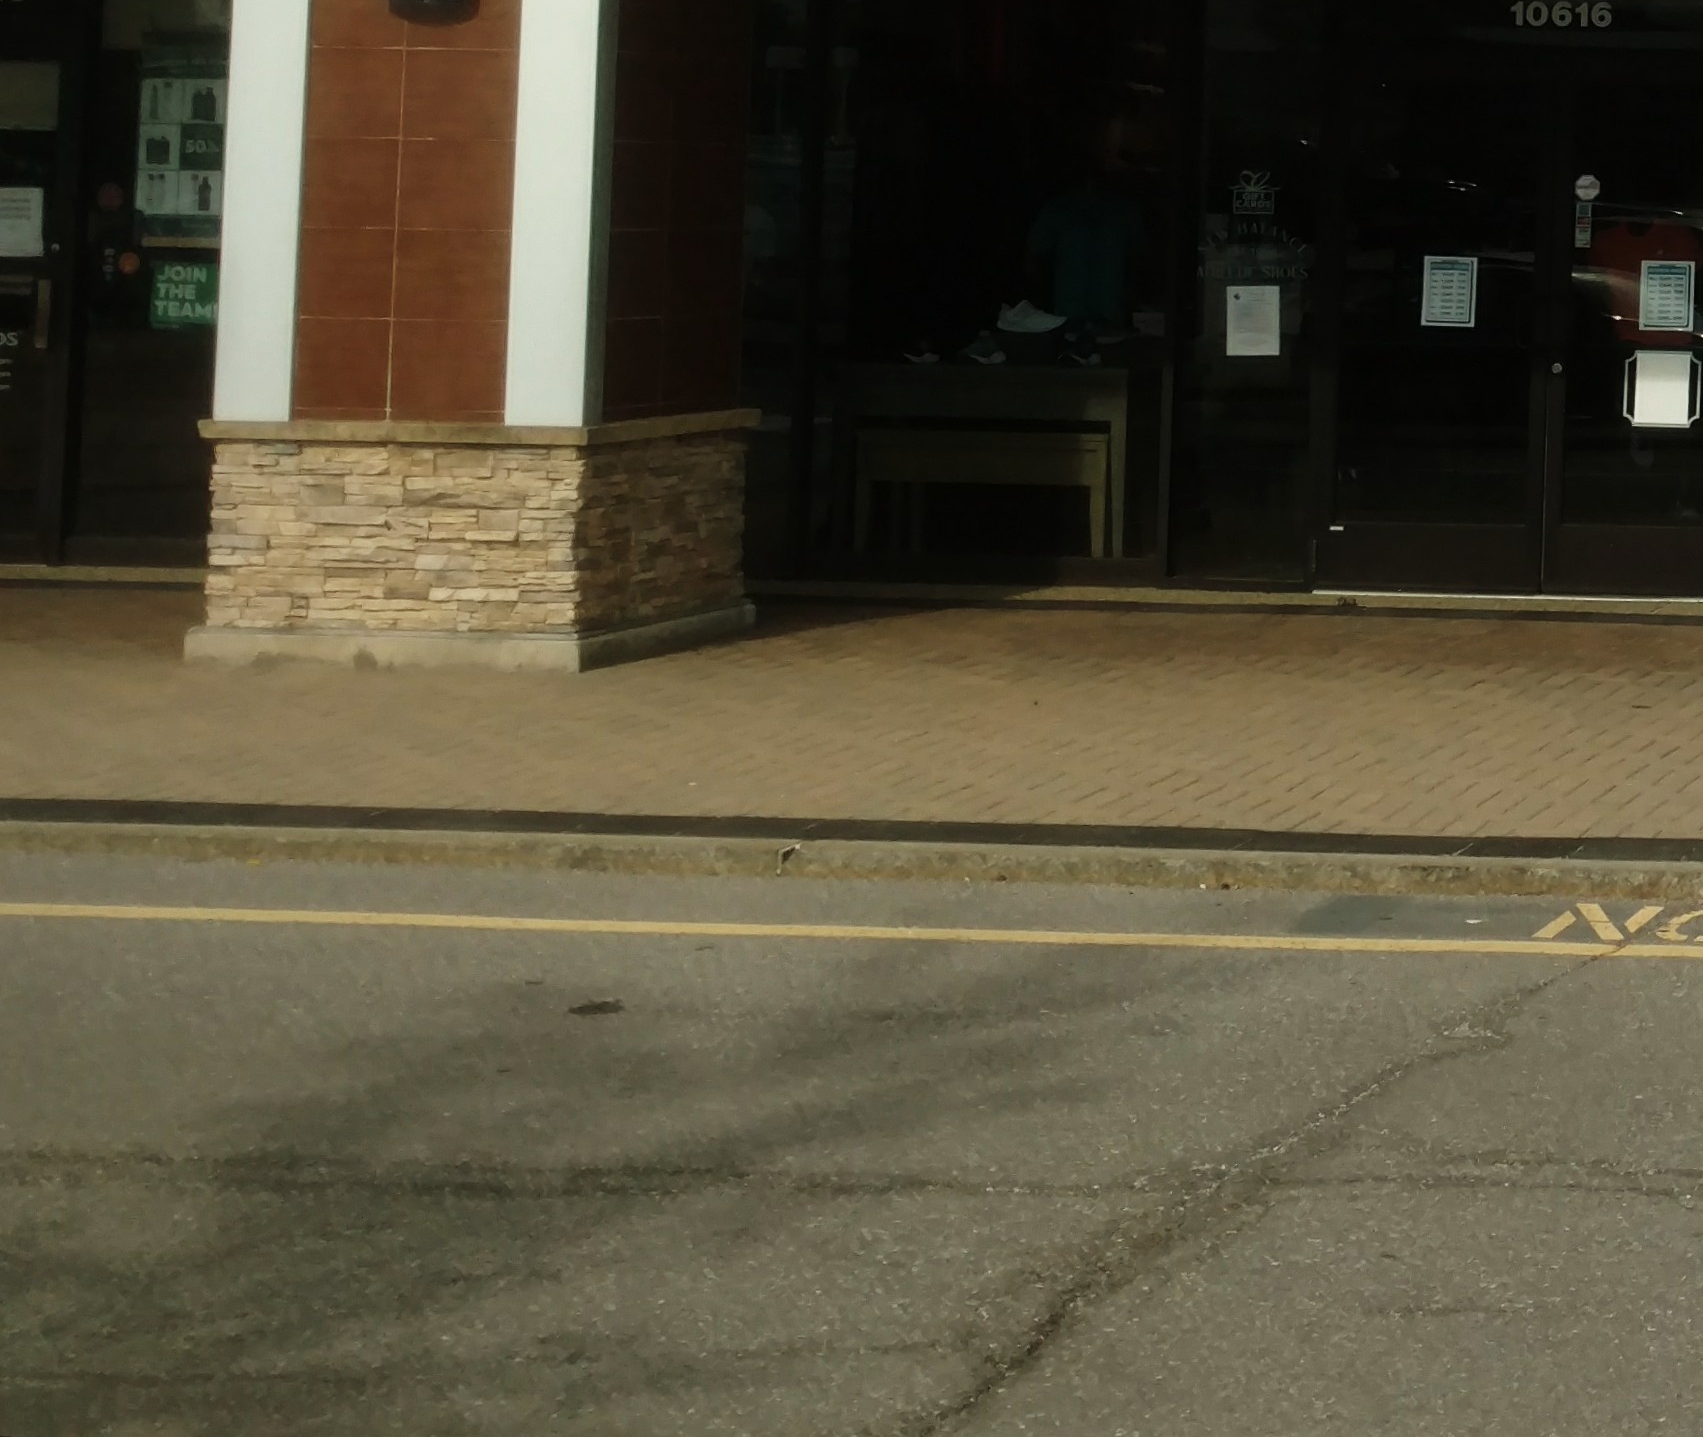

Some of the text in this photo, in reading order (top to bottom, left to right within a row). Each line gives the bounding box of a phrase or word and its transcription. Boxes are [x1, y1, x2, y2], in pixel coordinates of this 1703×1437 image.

[1510, 0, 1613, 28] 10616
[156, 265, 207, 283] JOIN
[156, 283, 197, 300] THE
